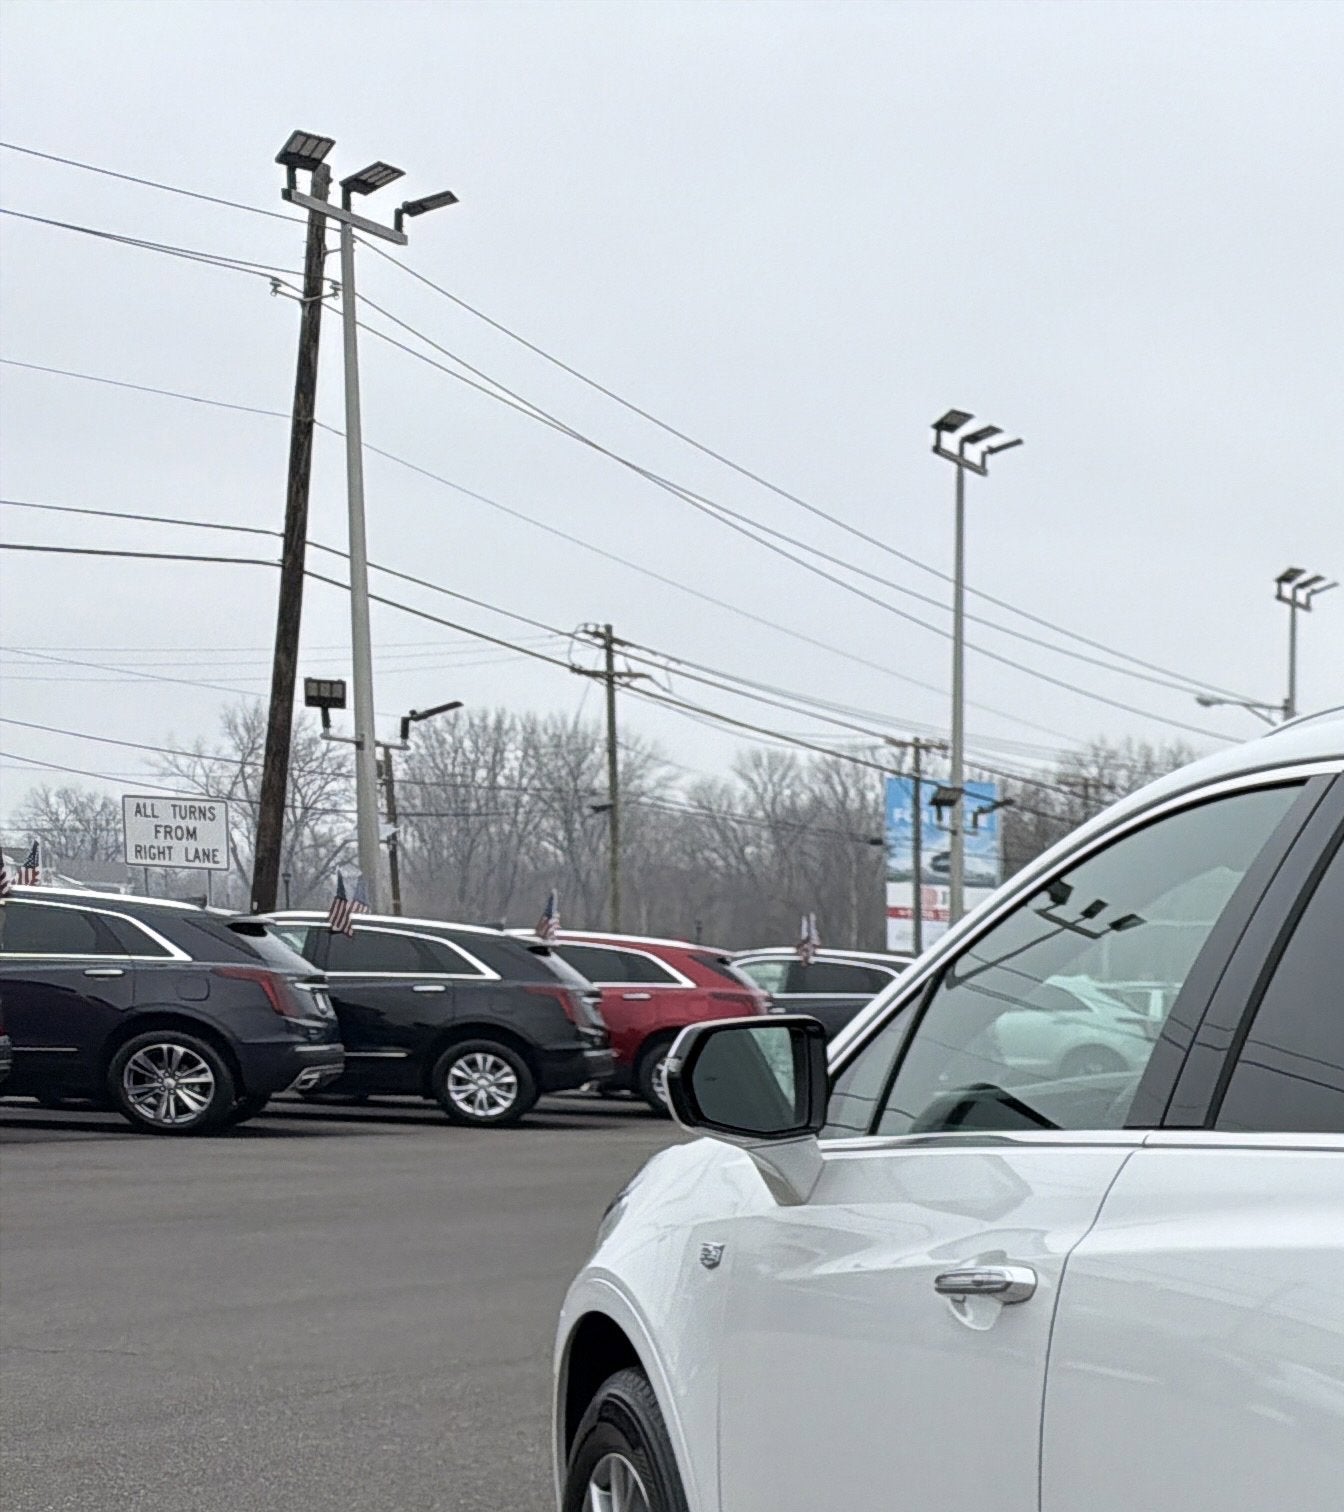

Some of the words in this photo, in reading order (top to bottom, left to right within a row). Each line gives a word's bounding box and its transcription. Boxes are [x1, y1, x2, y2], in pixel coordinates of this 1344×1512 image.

[134, 802, 159, 819] ALL
[170, 803, 217, 822] TURNS
[154, 824, 198, 841] FROM
[134, 844, 174, 861] RIGHT
[184, 846, 220, 865] LANE
